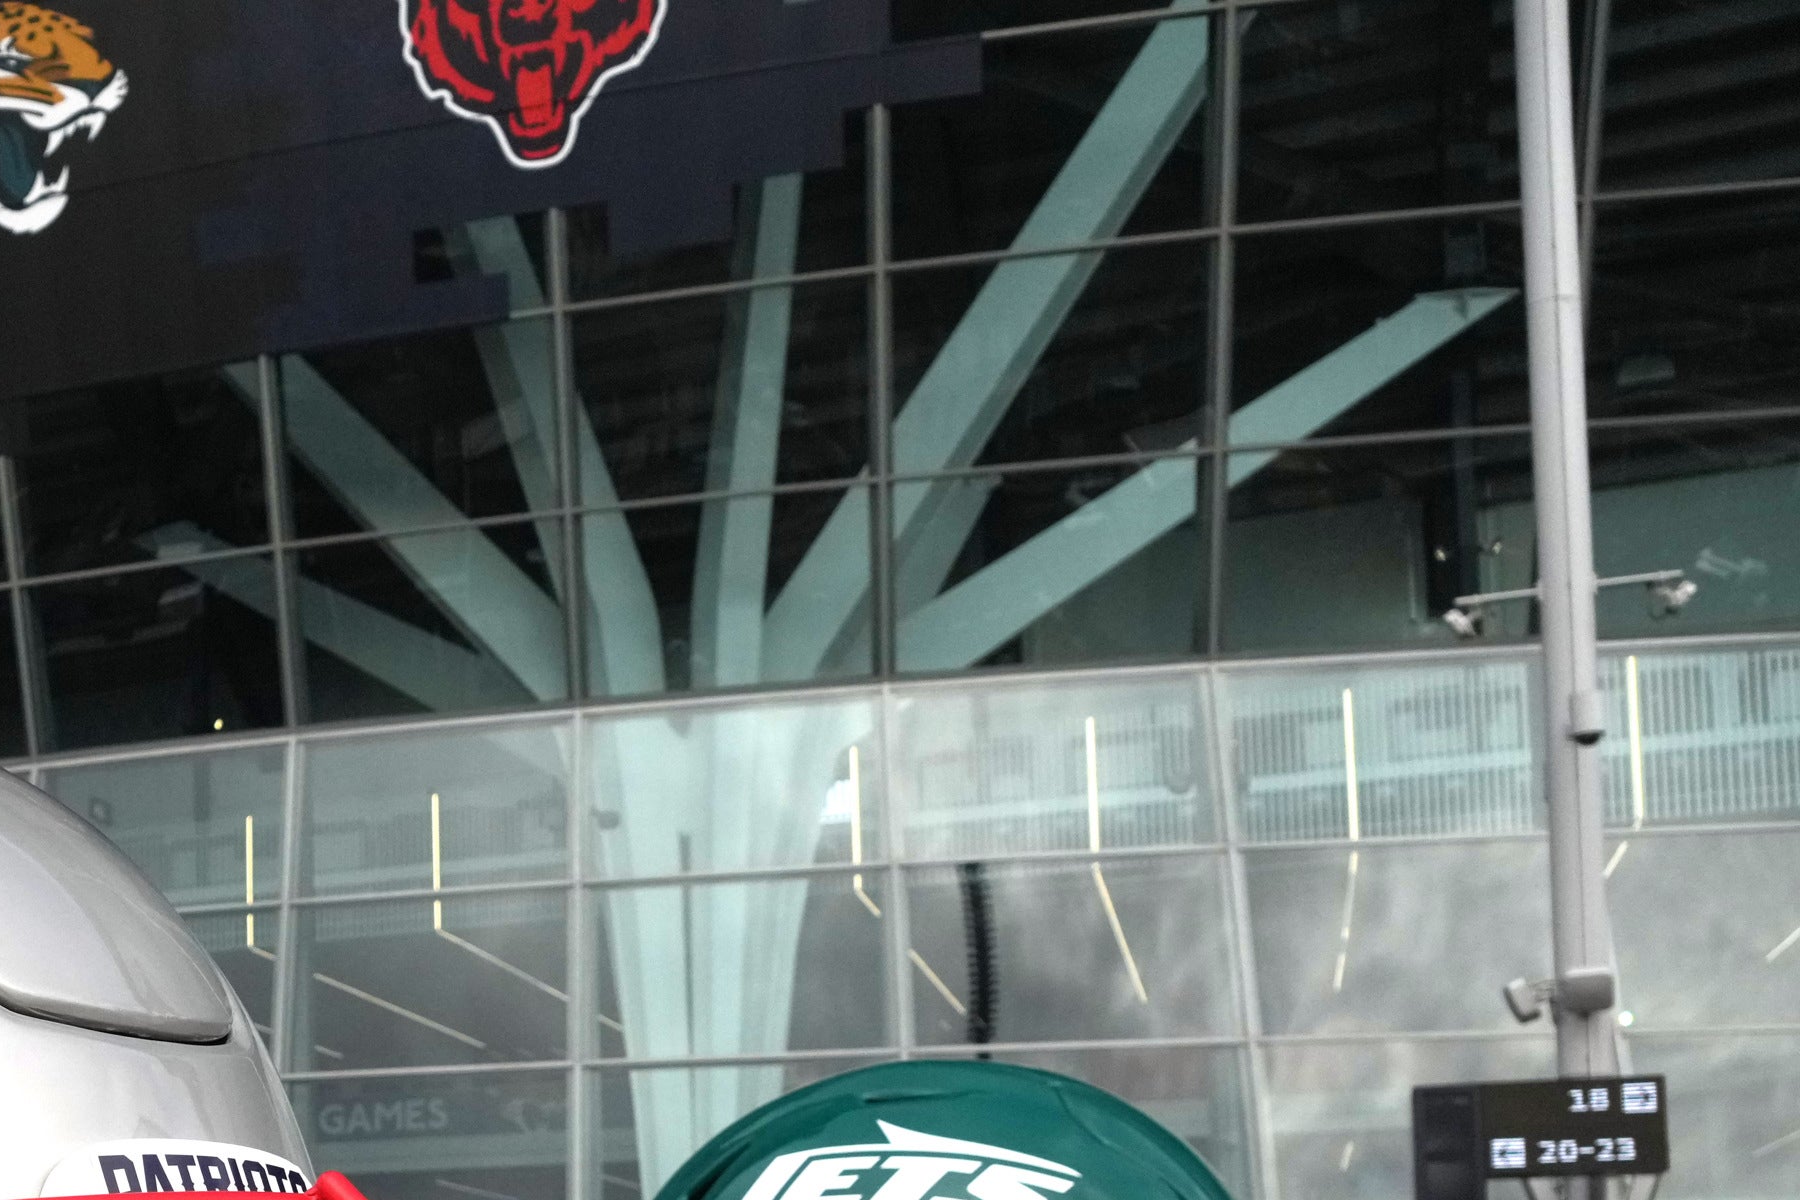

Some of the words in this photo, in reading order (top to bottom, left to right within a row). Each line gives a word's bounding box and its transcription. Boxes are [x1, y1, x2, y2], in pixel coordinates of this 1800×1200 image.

[1567, 1087, 1610, 1113] 18
[318, 1099, 448, 1135] GAMES
[1537, 1136, 1637, 1164] 20-23
